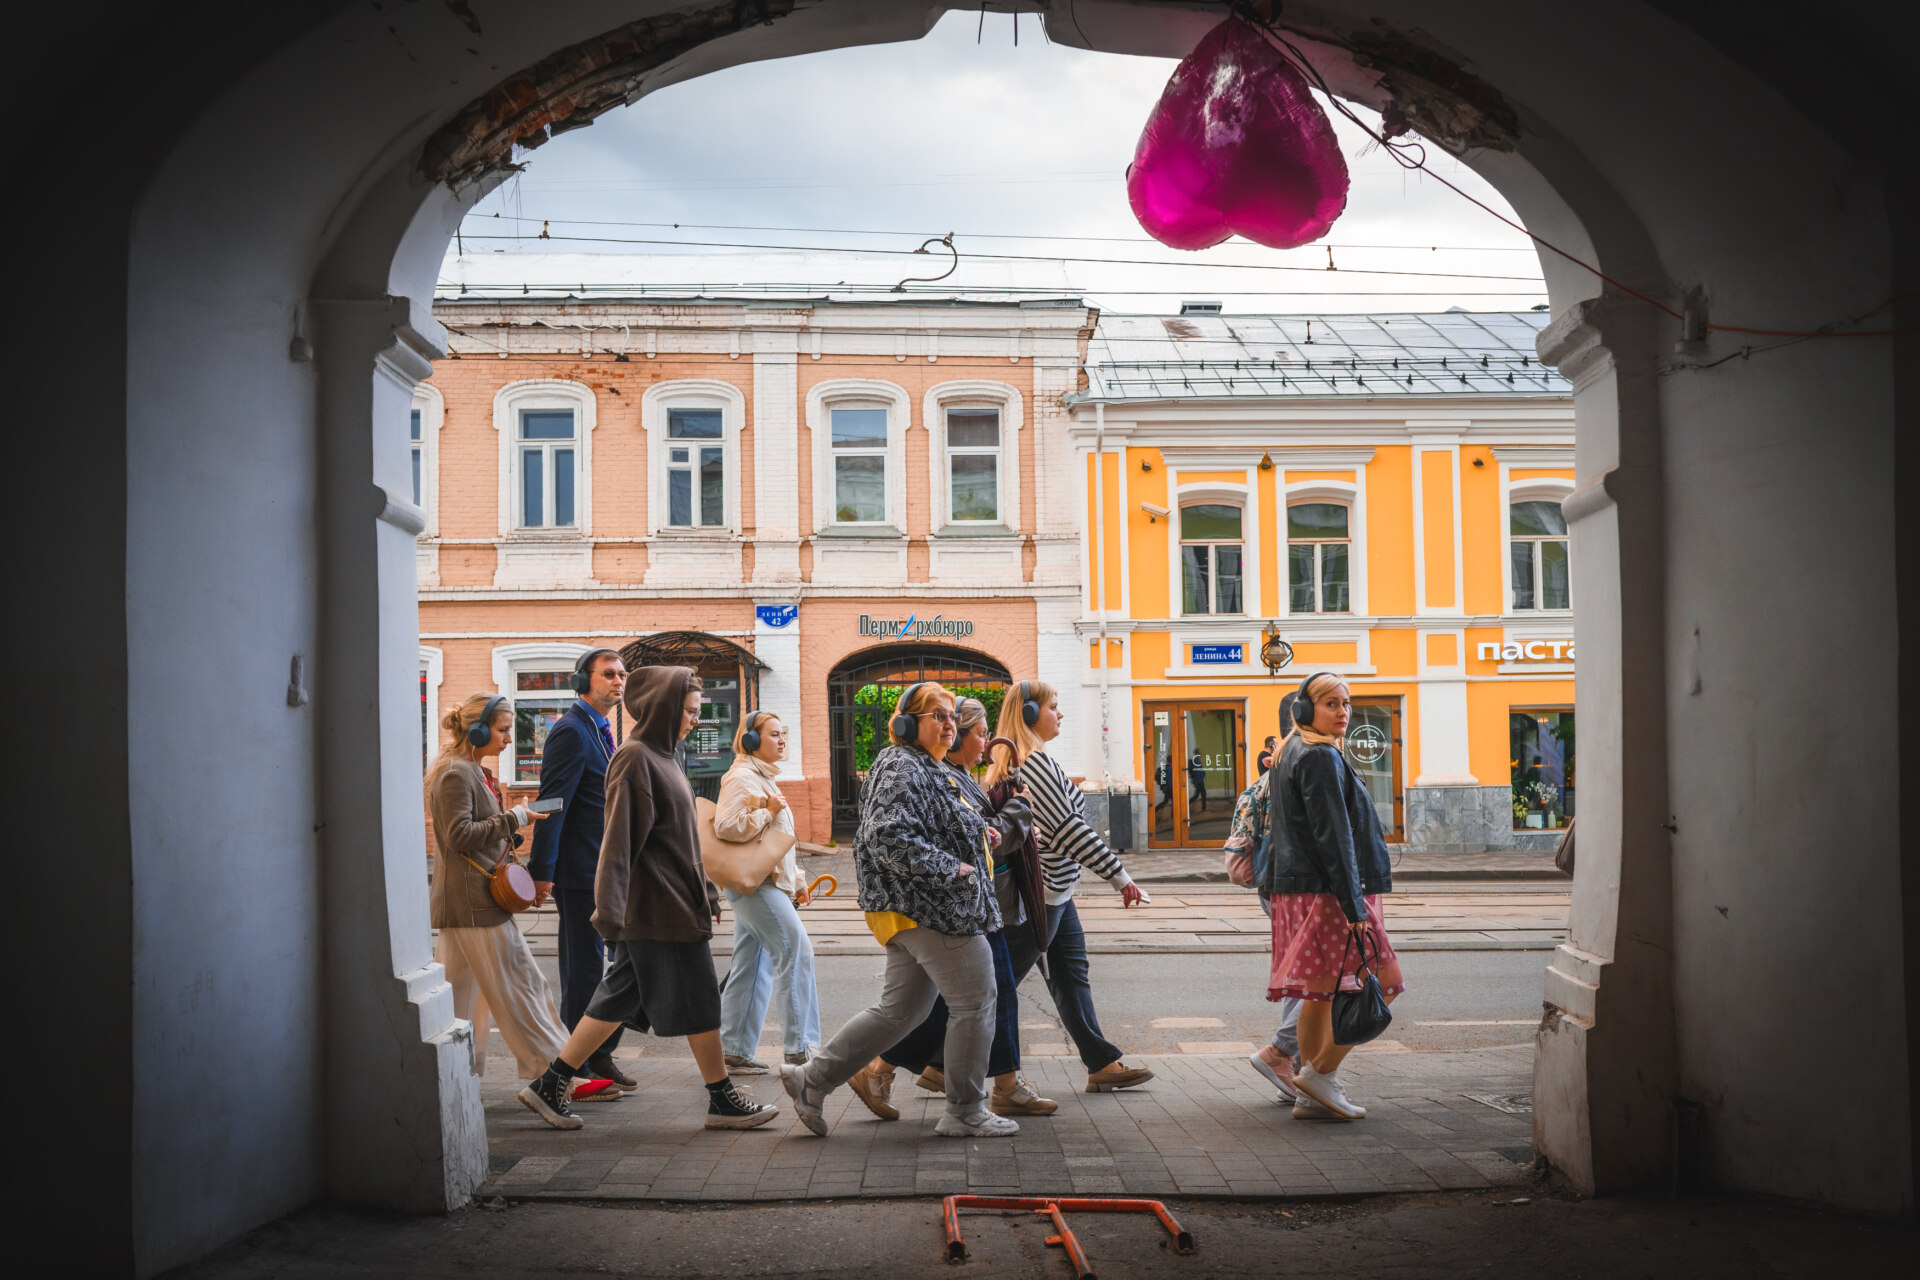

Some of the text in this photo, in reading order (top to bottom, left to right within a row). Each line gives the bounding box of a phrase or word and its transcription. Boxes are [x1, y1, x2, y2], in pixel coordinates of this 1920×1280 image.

[771, 617, 781, 626] 42
[1228, 648, 1242, 660] 44
[1192, 754, 1231, 766] СВЕТ
